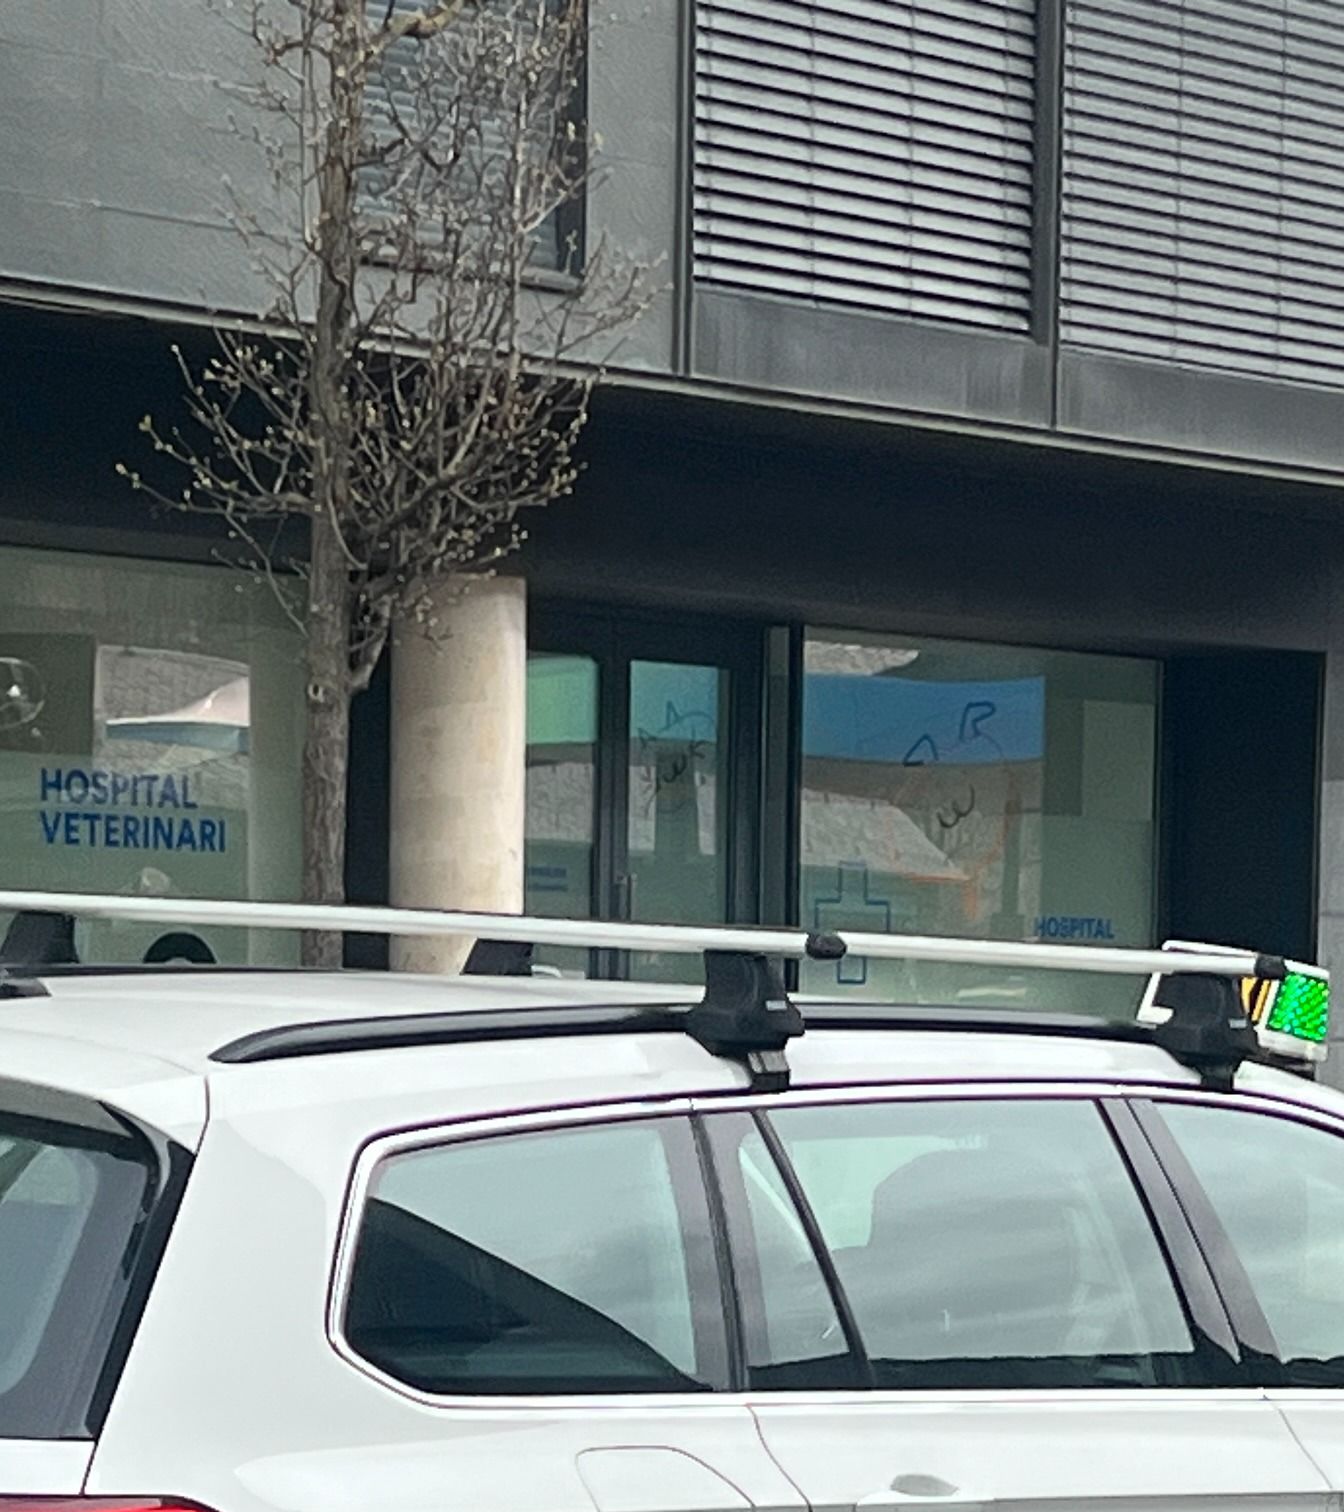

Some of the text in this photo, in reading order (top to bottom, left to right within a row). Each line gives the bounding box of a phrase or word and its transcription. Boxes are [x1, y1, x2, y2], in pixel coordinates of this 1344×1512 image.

[40, 768, 198, 809] HOSPITAL
[40, 811, 226, 853] VETERINARI
[1034, 917, 1115, 938] HOSPITAL
